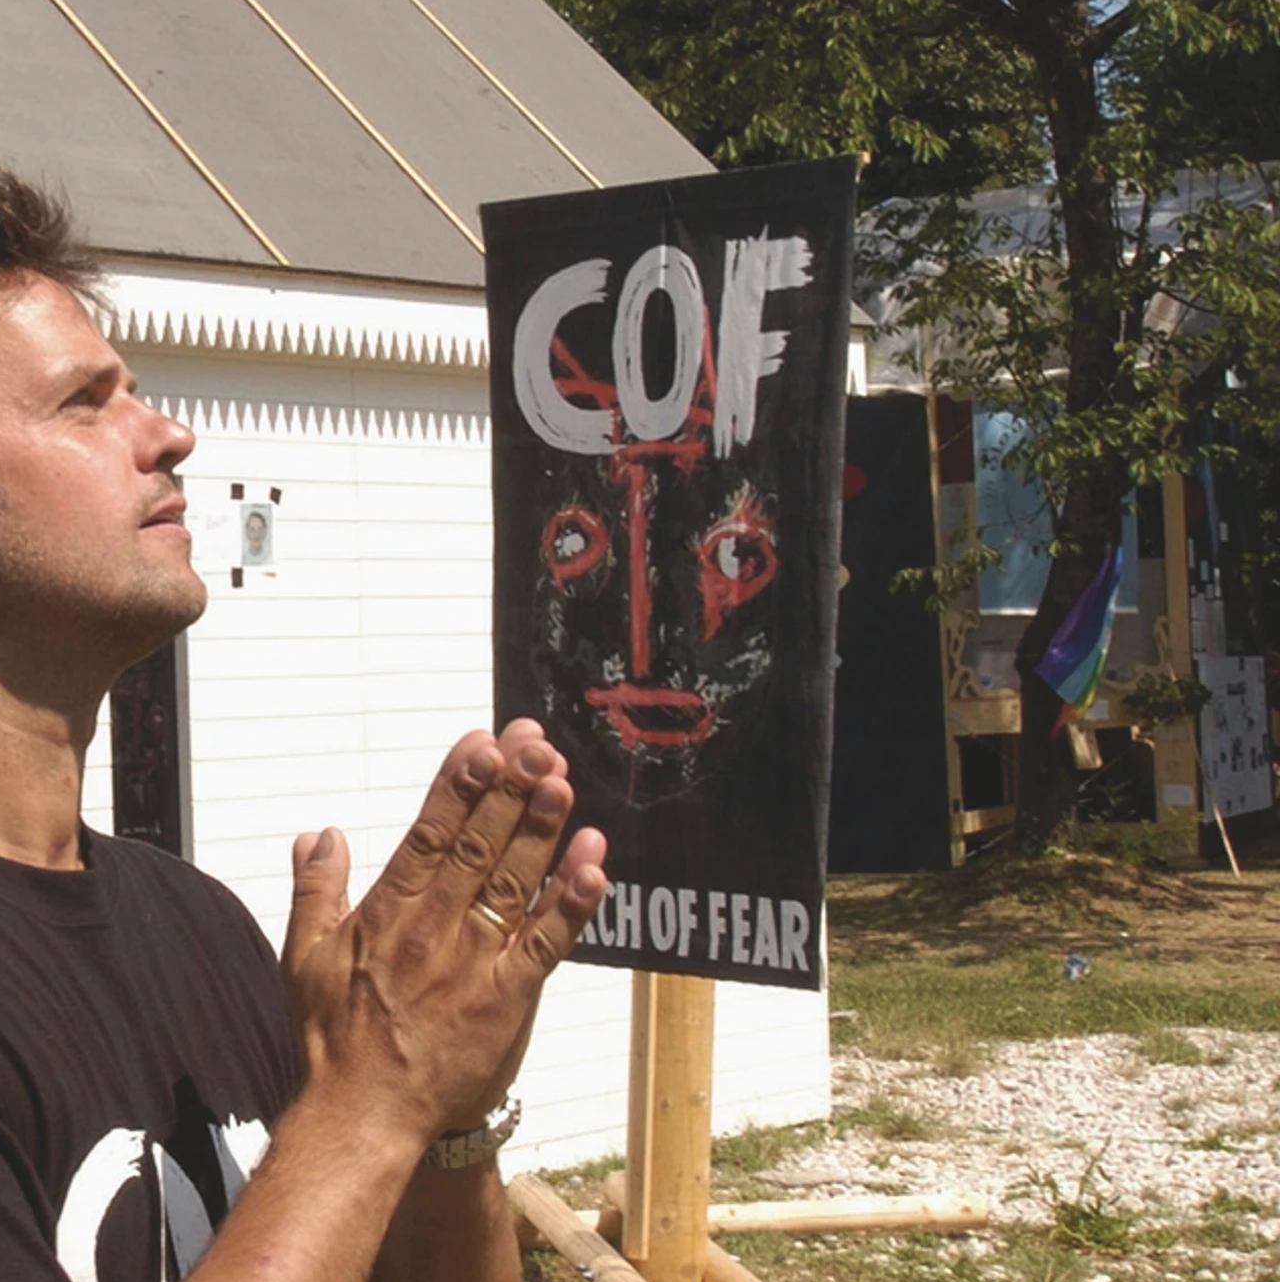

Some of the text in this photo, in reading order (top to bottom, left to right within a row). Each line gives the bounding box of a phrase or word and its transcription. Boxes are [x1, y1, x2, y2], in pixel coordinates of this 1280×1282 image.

[513, 224, 815, 459] COF
[647, 886, 698, 957] OF
[708, 891, 810, 971] FEAR
